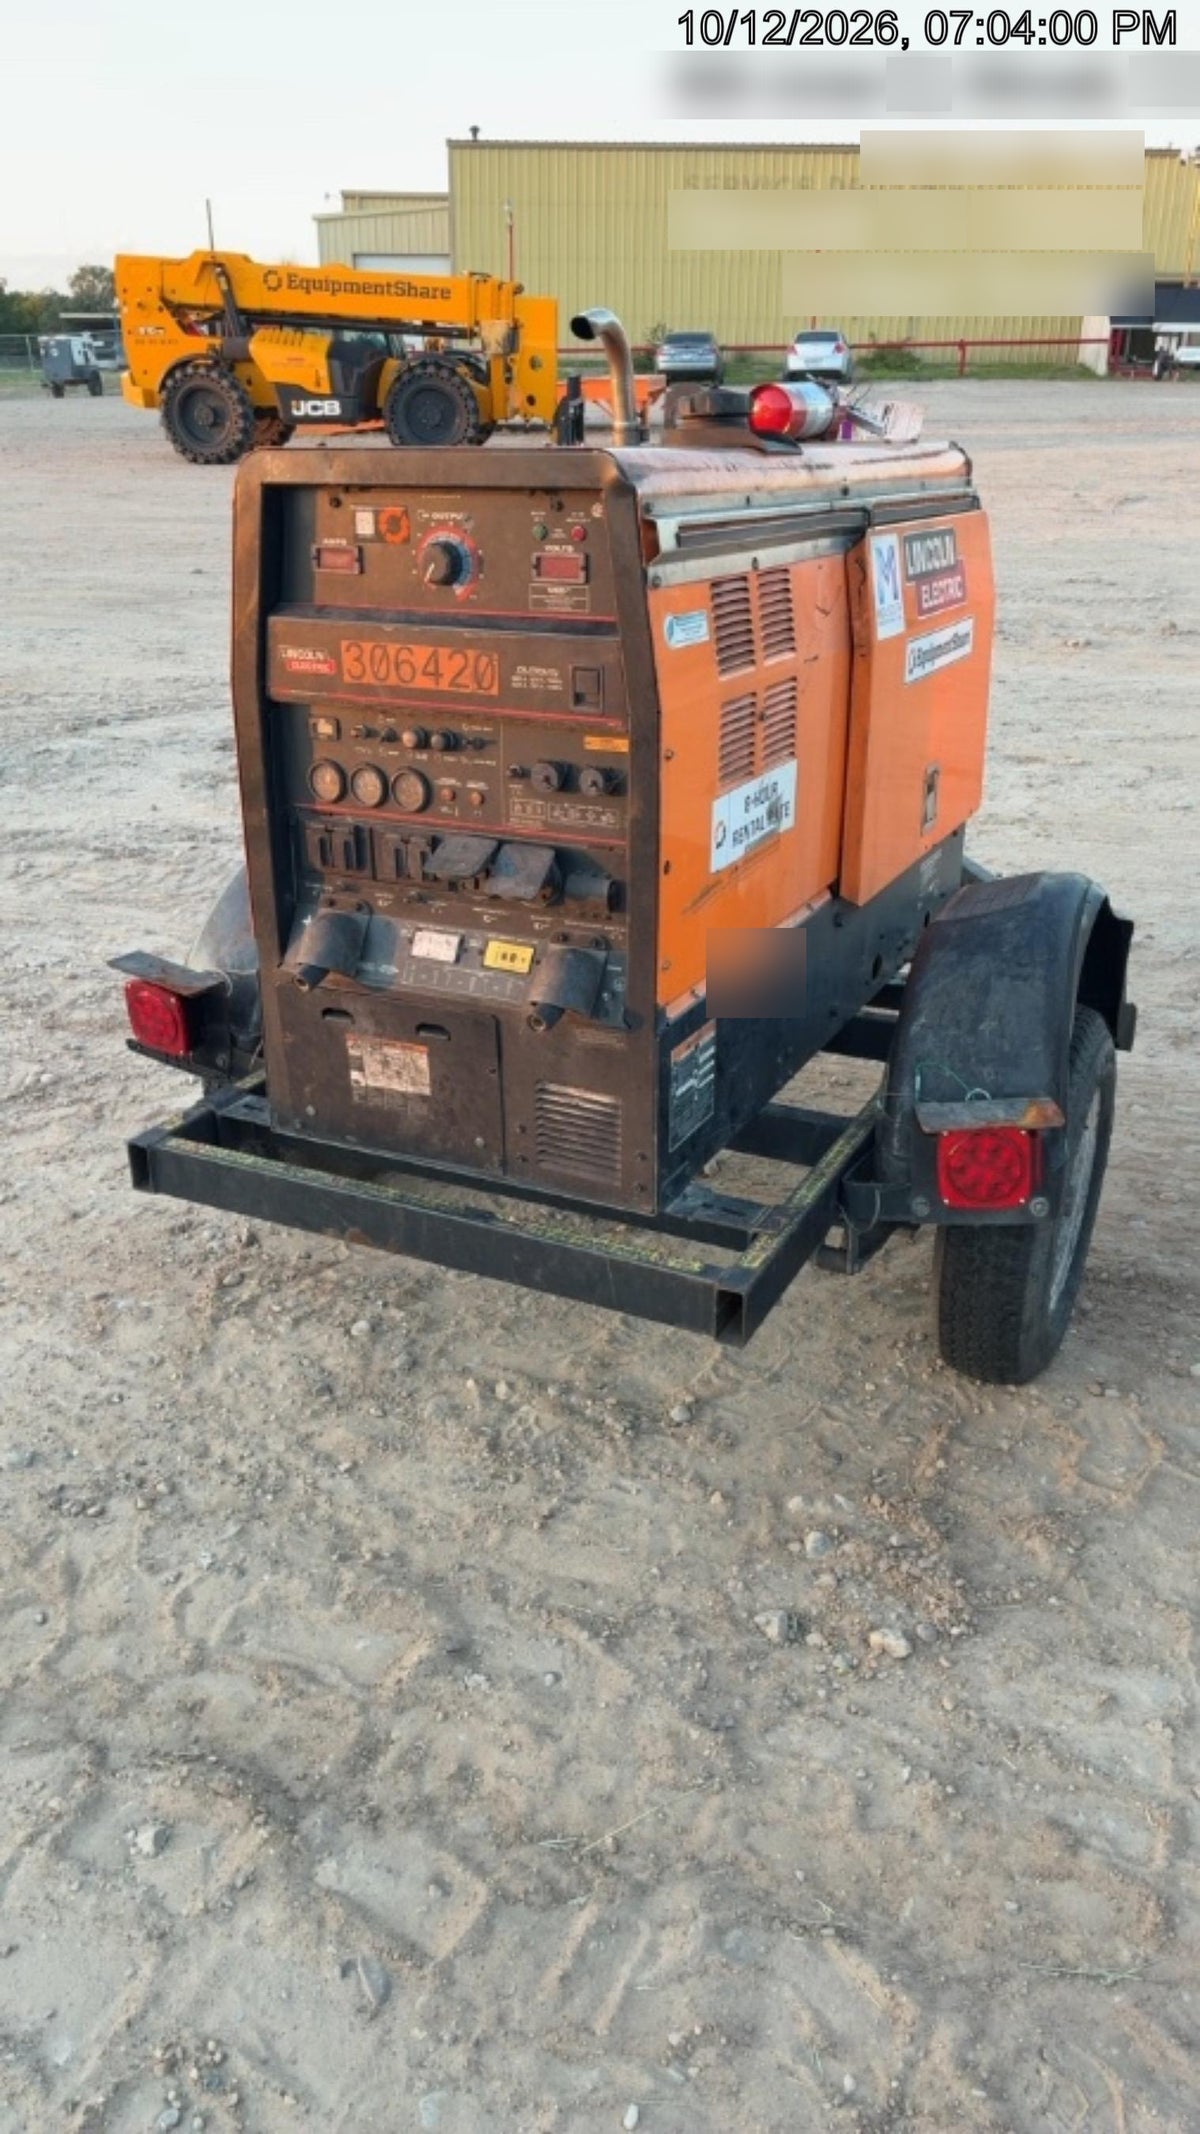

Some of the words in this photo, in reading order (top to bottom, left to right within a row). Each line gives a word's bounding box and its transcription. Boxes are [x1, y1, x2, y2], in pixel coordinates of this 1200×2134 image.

[287, 272, 452, 300] EquipmentShare
[291, 399, 341, 416] JCB
[904, 532, 956, 577] LINCOLN
[921, 575, 964, 610] ELECTRIC
[344, 641, 498, 691] 306420
[732, 813, 766, 848] RENTAL
[766, 799, 791, 828] ATE
